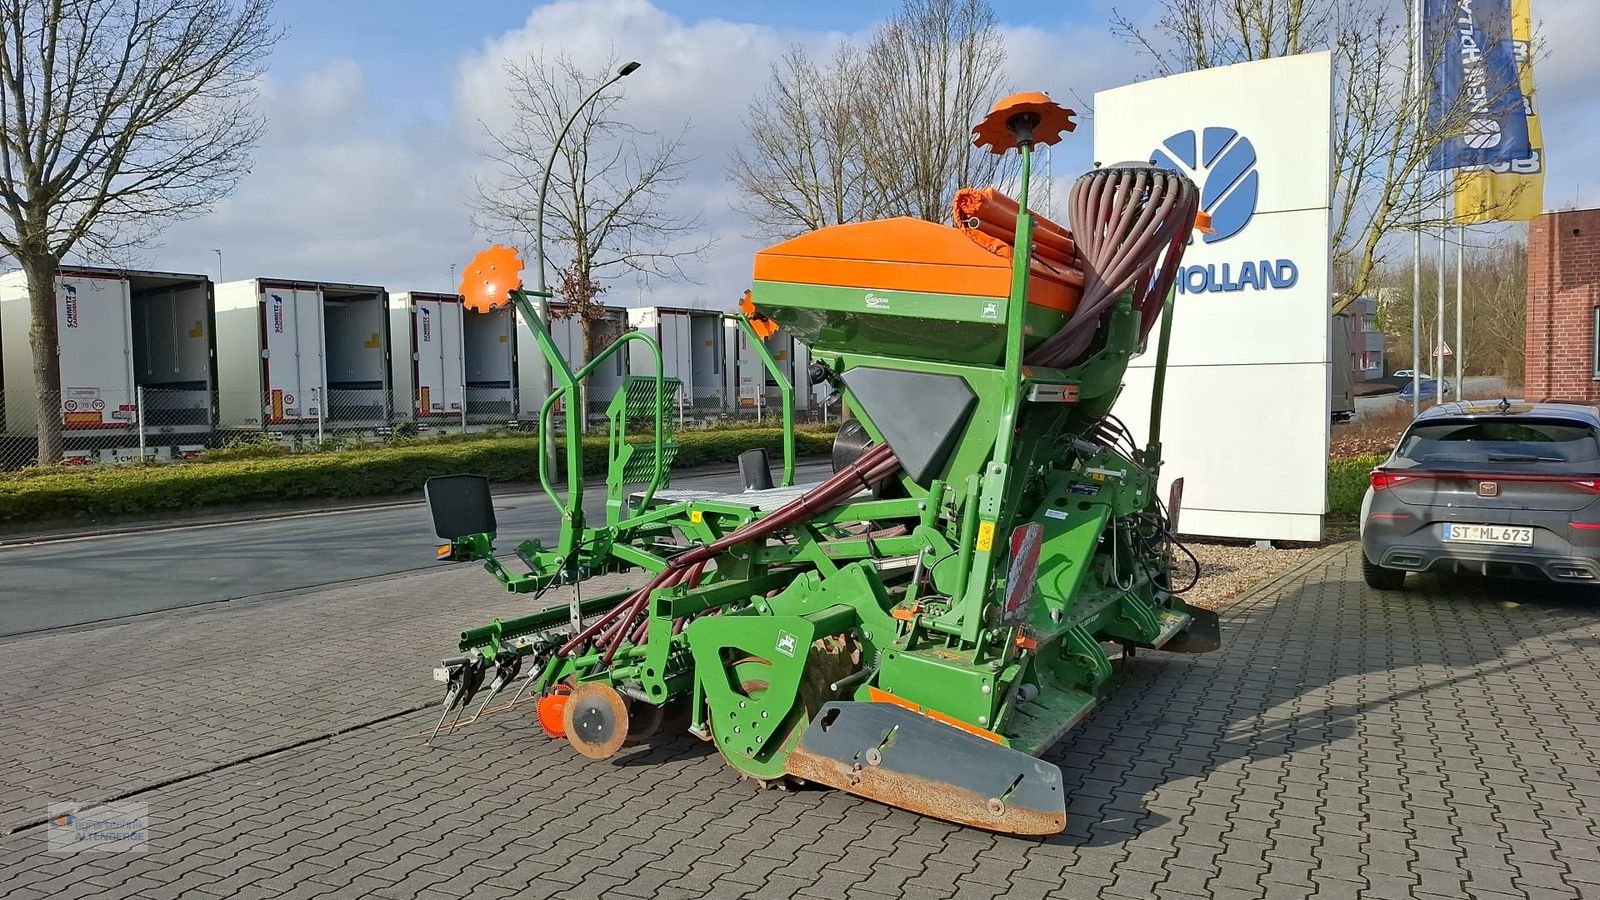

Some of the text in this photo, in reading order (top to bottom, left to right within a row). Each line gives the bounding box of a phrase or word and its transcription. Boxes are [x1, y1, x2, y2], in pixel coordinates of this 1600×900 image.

[1452, 526, 1531, 542] ST ML 673
